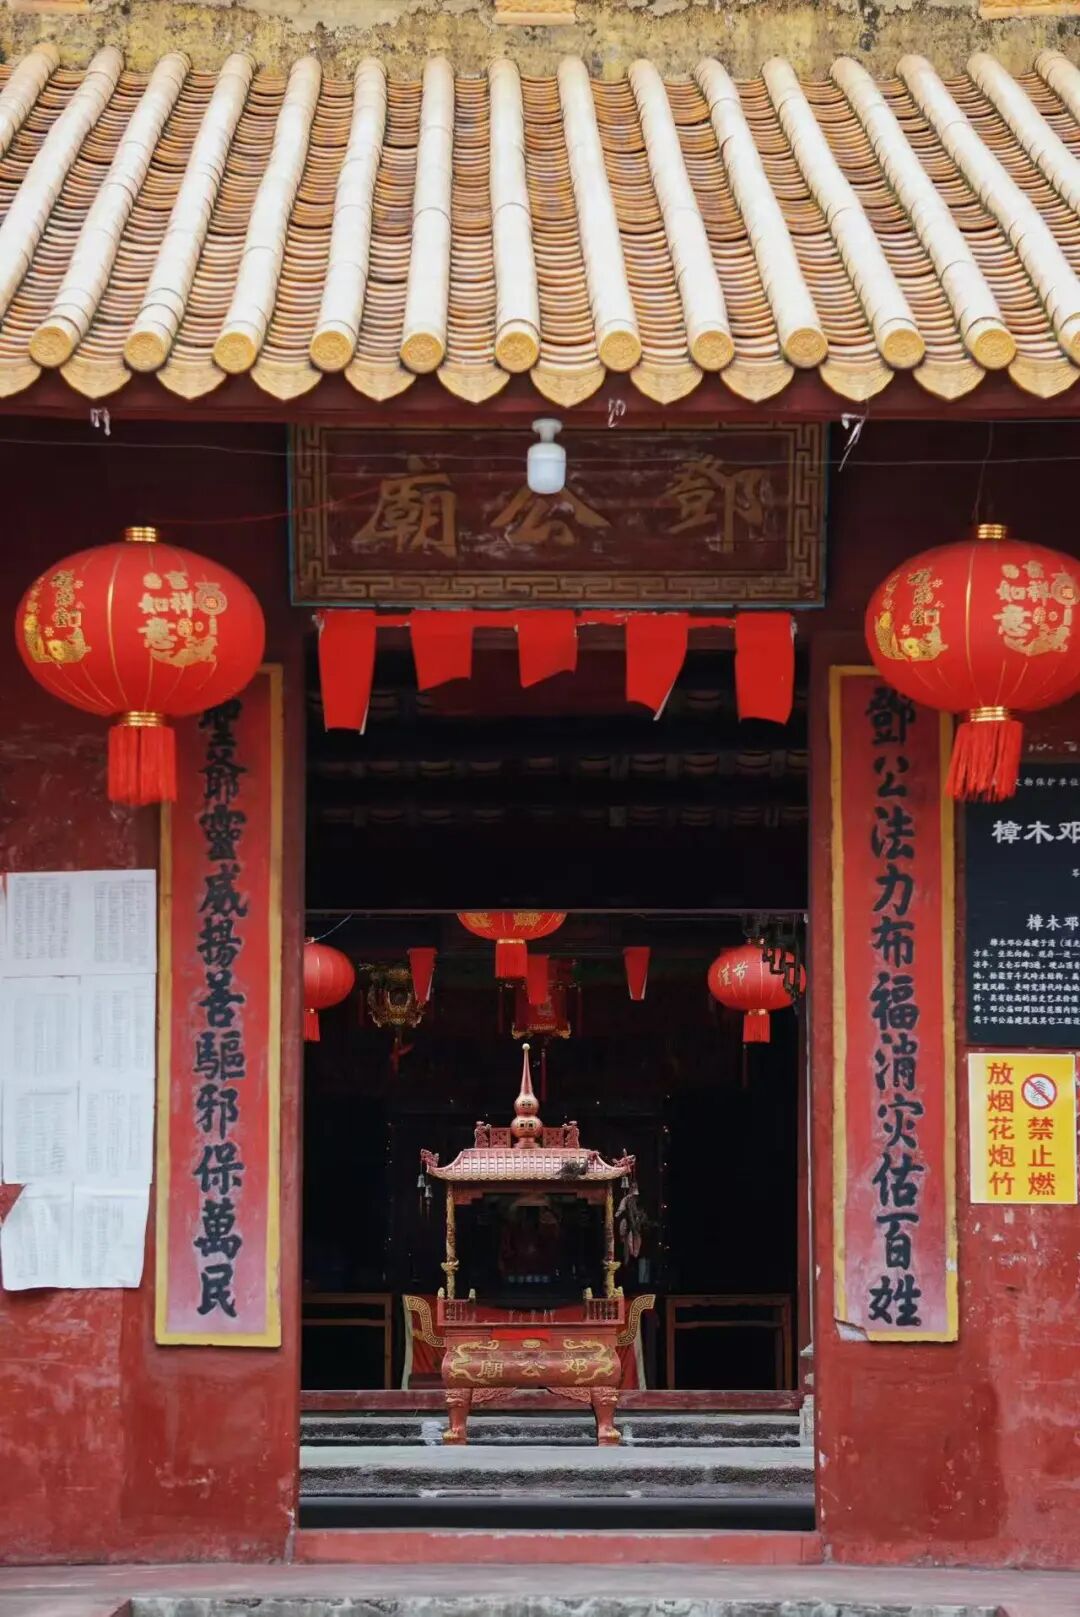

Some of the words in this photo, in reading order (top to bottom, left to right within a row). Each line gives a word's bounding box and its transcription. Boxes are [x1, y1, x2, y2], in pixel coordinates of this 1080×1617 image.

[991, 820, 1080, 844] 樟木邓
[1026, 913, 1080, 931] 樟木邓
[986, 1062, 1016, 1196] 放烟花炮竹
[1027, 1117, 1056, 1196] 禁止燃
